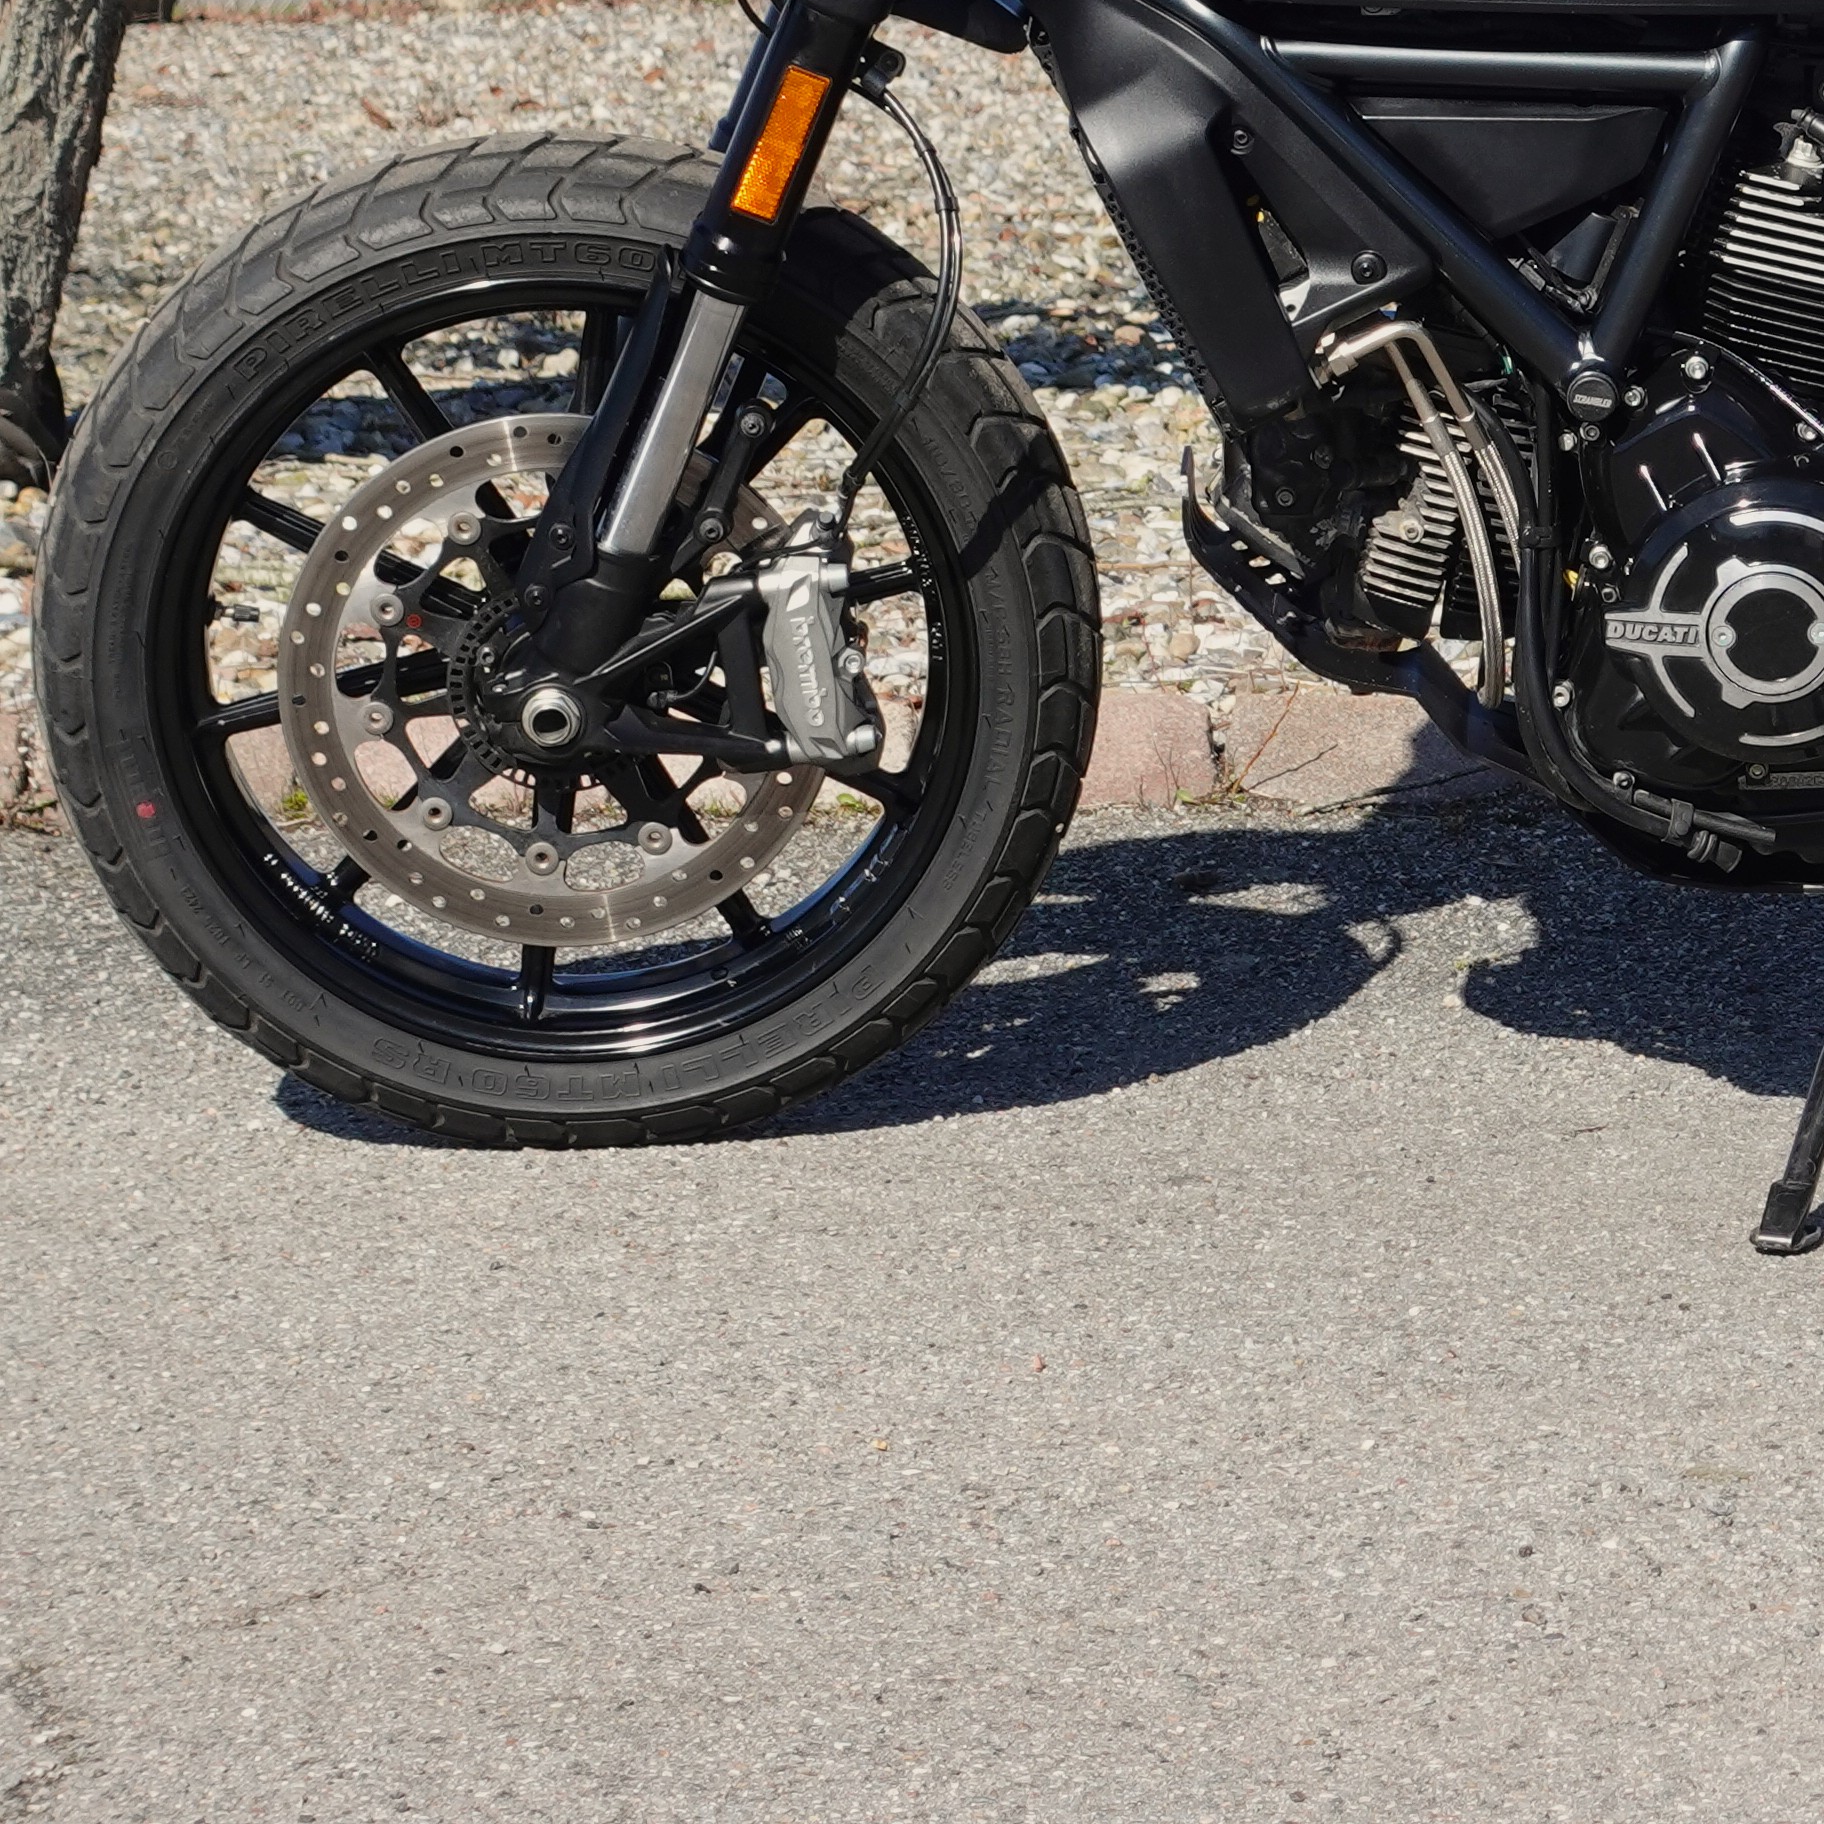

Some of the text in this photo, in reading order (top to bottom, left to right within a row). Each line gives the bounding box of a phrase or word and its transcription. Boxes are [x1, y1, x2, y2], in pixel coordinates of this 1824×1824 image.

[232, 239, 657, 381] PIRELLI MT60
[790, 615, 827, 727] brembo
[1606, 623, 1697, 644] DUCATI
[367, 964, 887, 1101] PIRELLI MT60 RS
